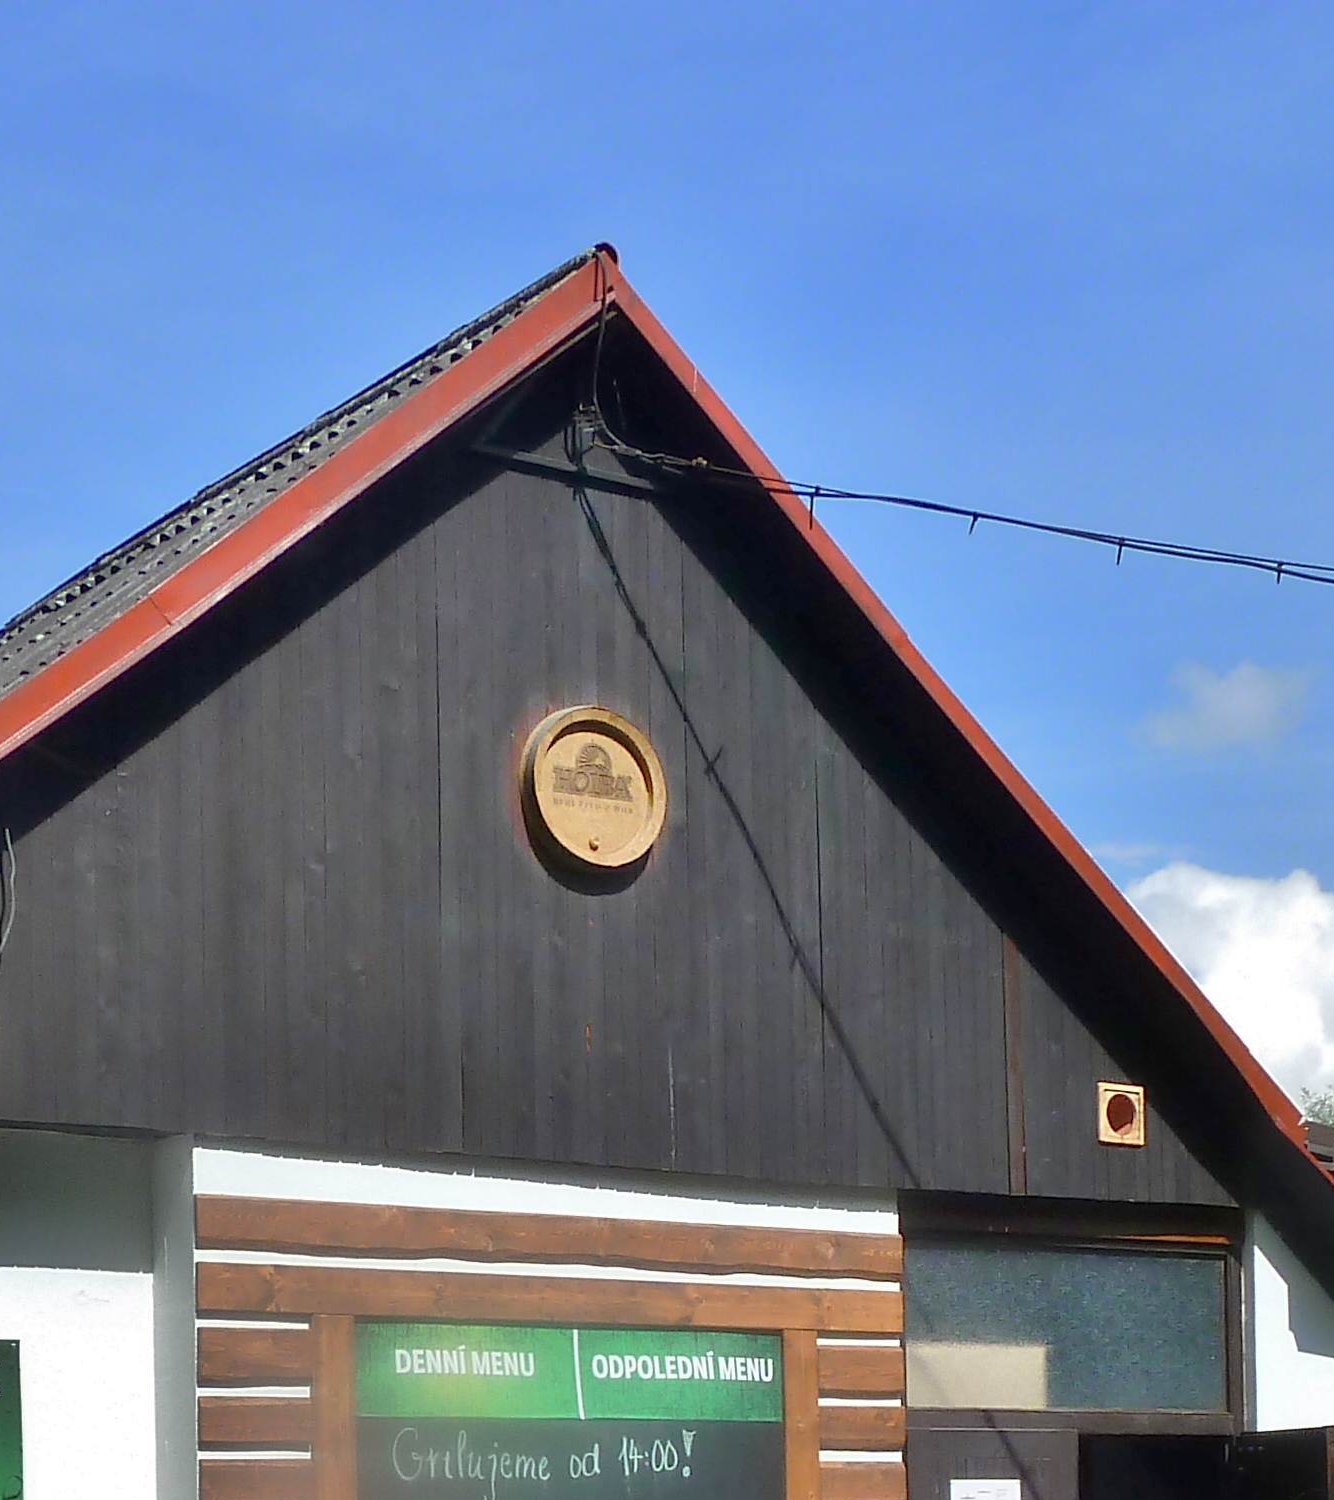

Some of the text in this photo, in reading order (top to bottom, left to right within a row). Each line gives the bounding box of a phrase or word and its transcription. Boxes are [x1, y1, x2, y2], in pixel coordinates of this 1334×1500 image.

[394, 1344, 535, 1377] DENNÍ MENU
[591, 1350, 774, 1382] ODPOLEDNÍ MENU
[569, 1442, 601, 1479] od
